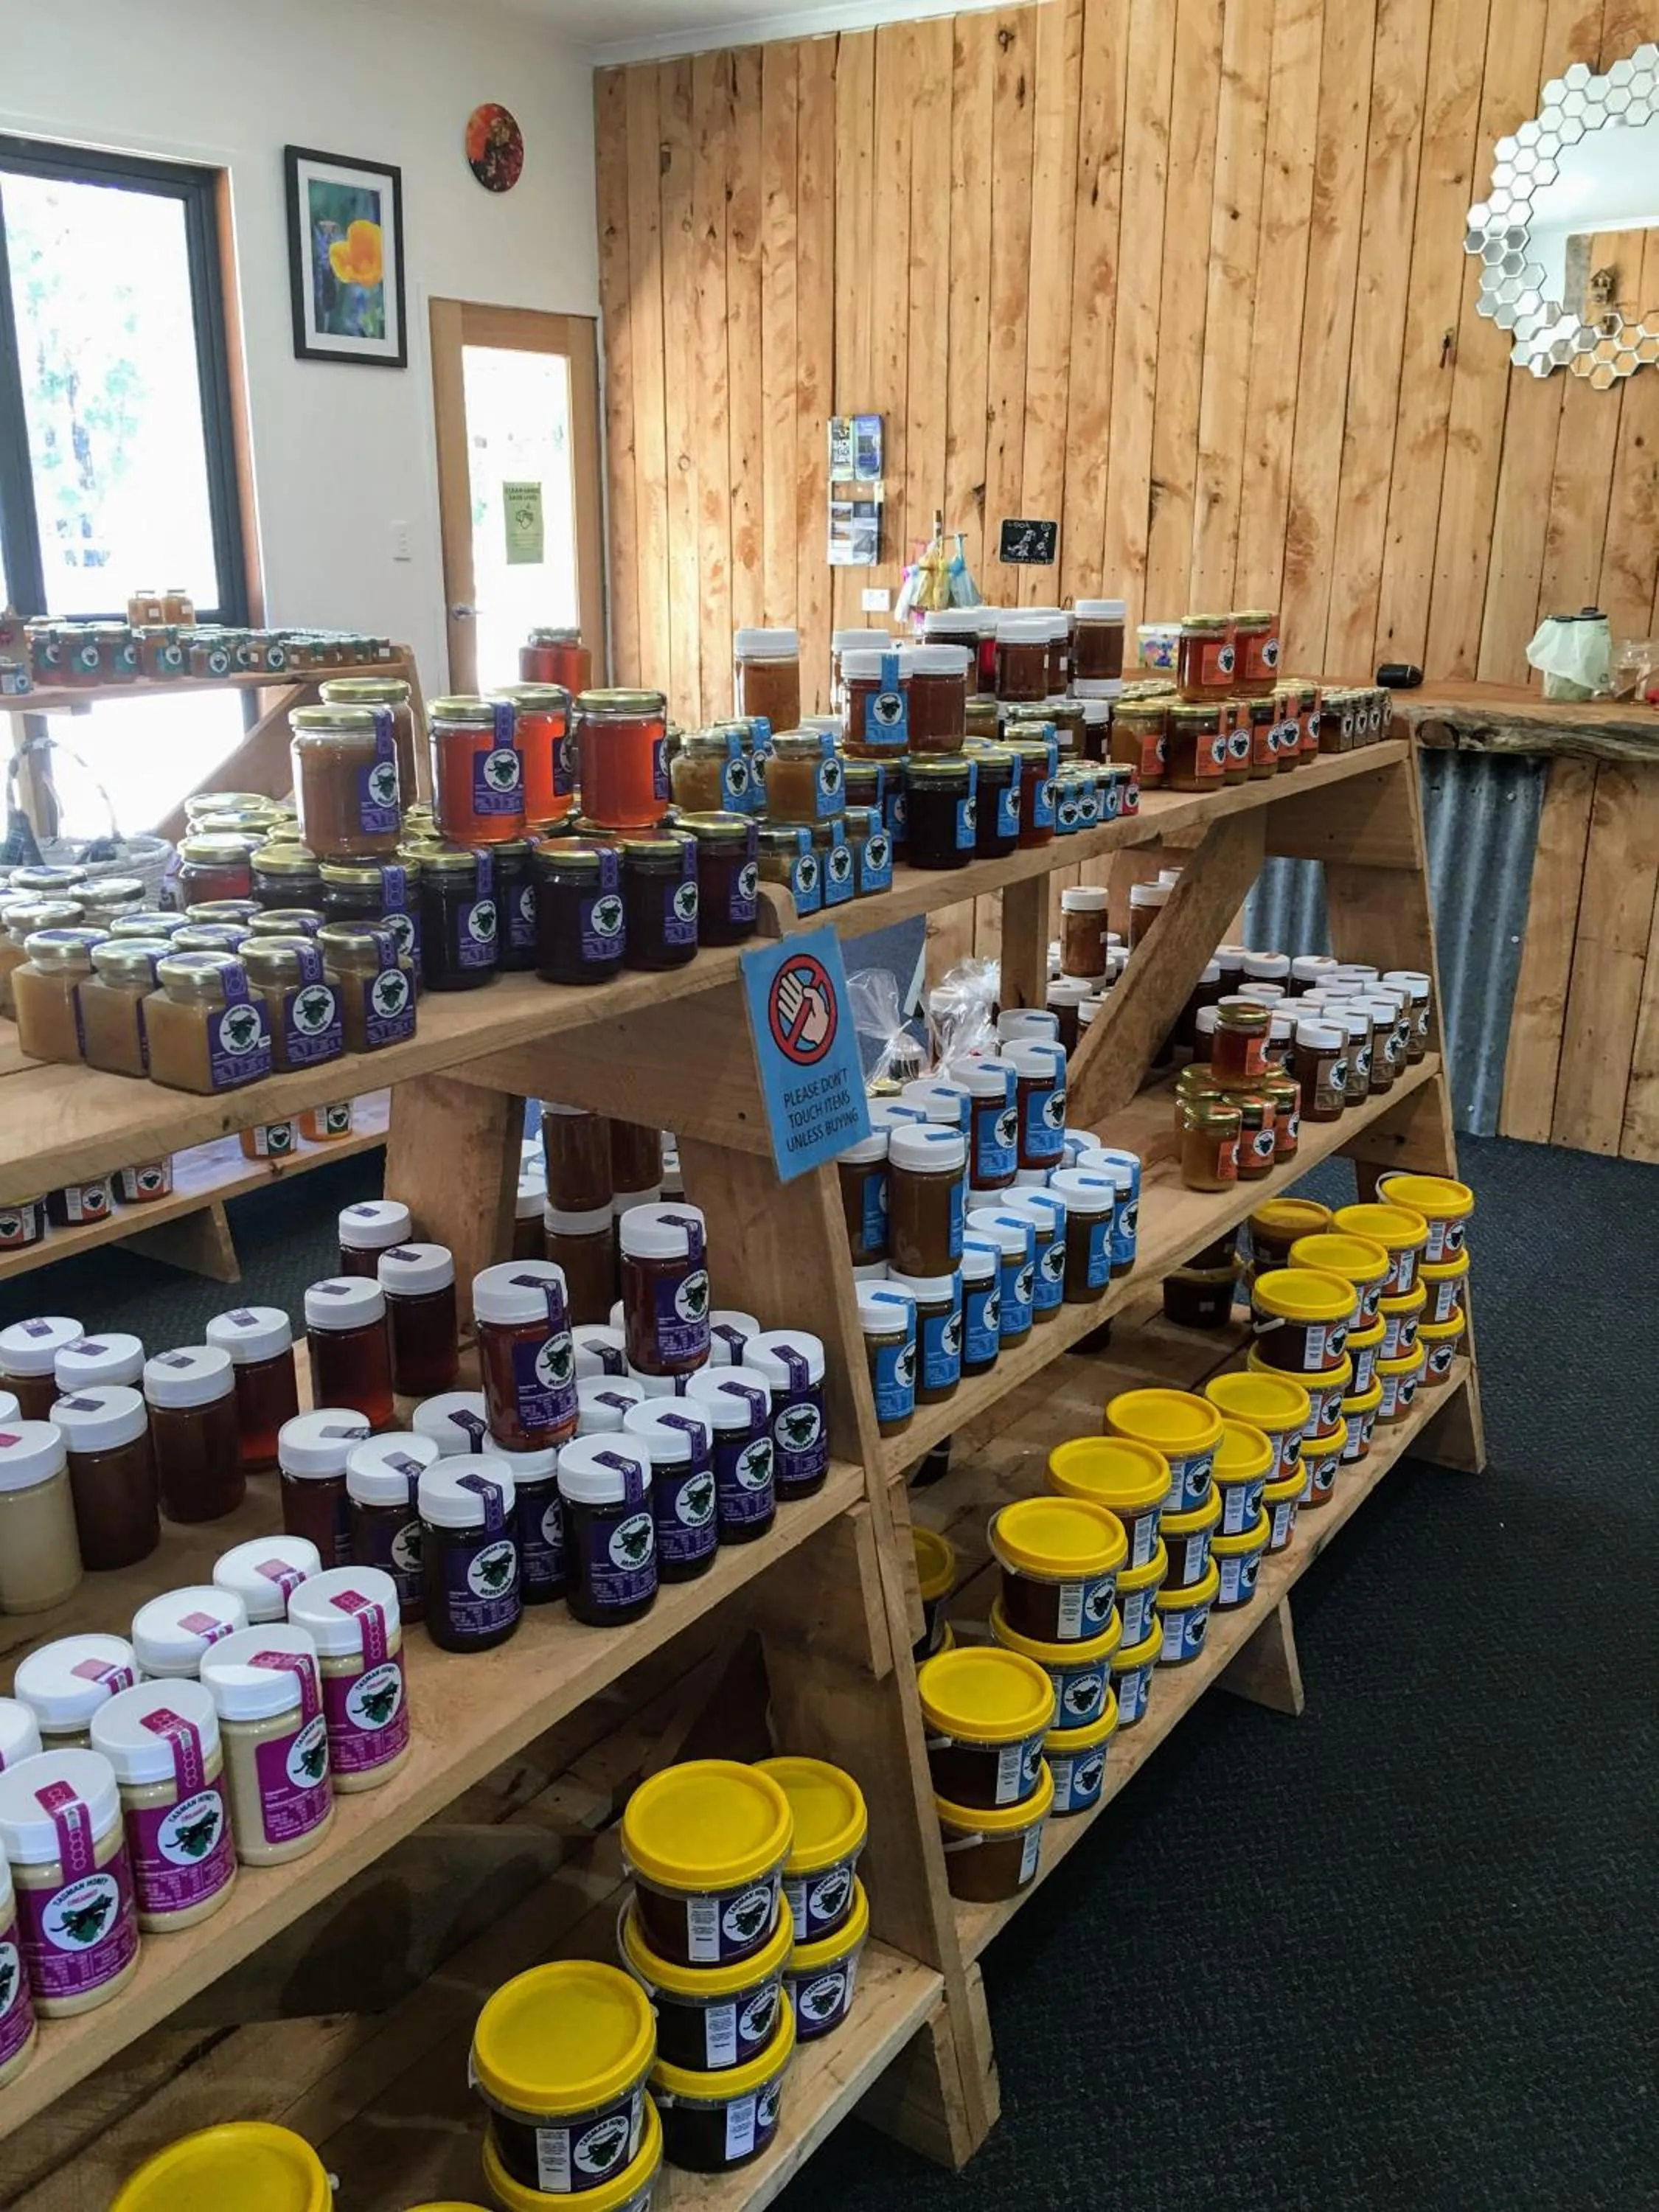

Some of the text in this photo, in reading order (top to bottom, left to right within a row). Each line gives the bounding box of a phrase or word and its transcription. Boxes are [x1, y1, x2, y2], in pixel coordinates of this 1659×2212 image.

[783, 1068, 849, 1109] PLEASE DON'T
[786, 1107, 859, 1153] UNLESS BUYING
[788, 1090, 850, 1130] TOUCH ITEMS
[52, 1882, 86, 1907] TASMAN
